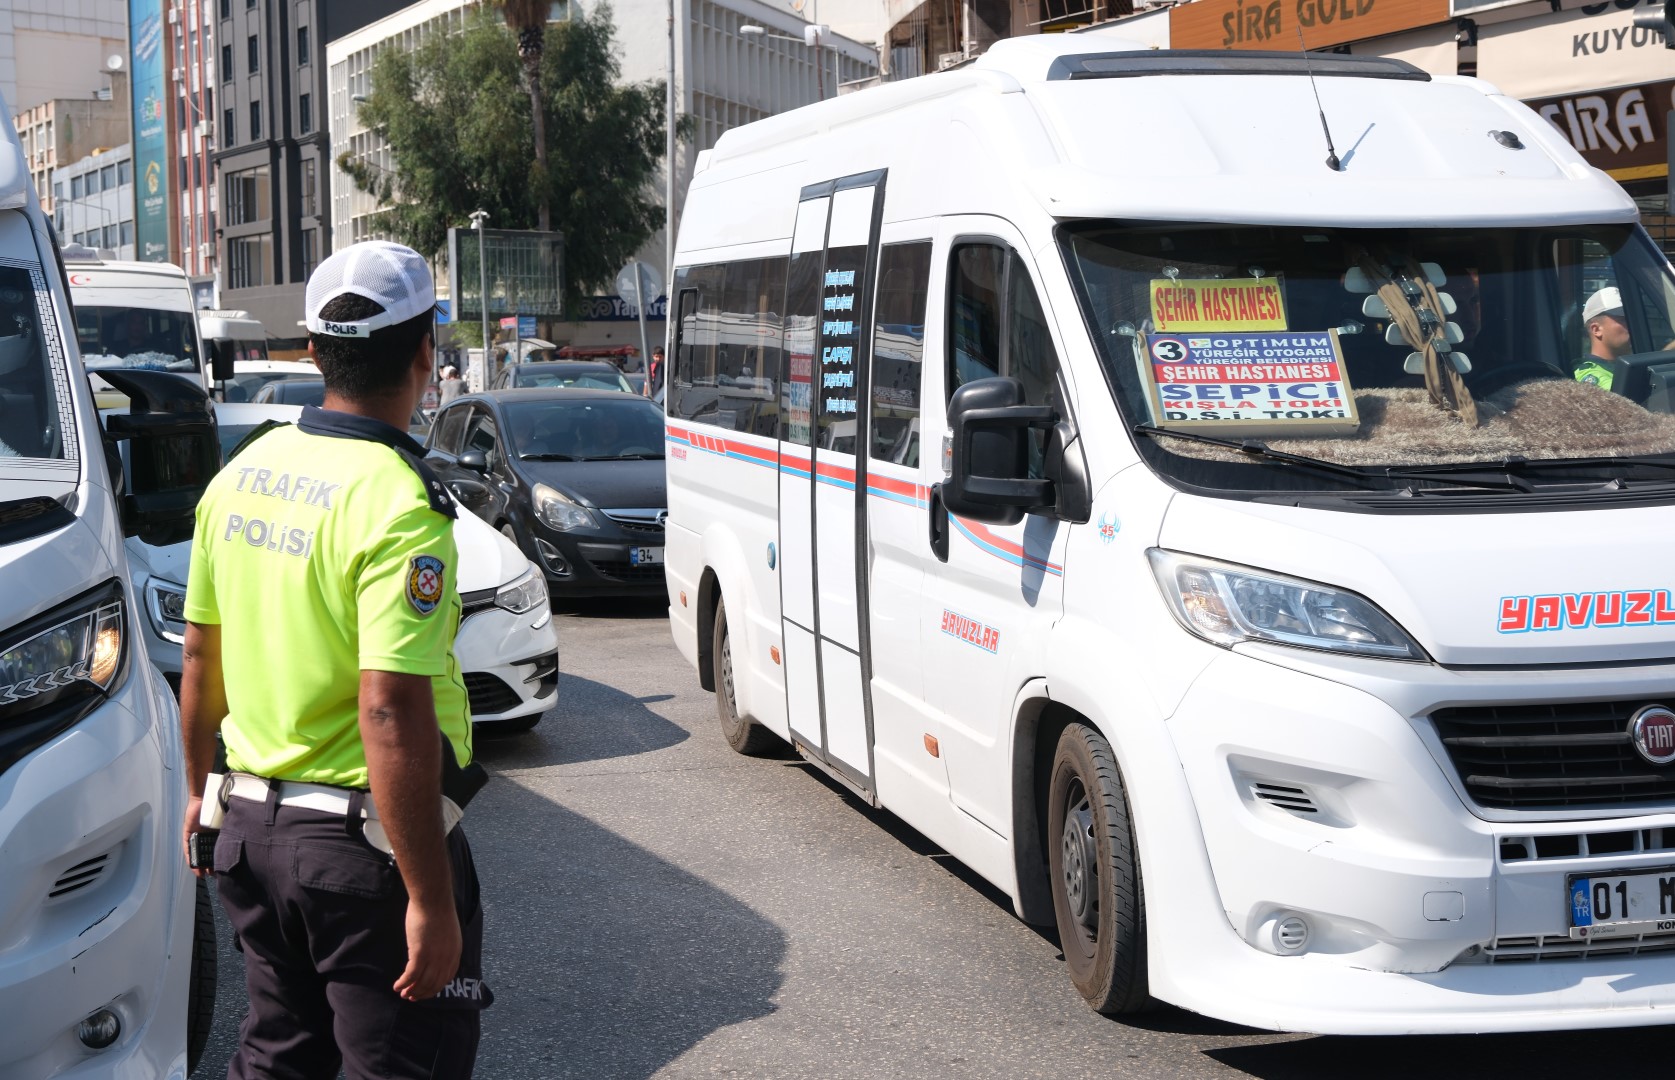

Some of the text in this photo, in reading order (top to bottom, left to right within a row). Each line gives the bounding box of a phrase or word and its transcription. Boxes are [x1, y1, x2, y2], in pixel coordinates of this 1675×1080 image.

[612, 299, 641, 318] Yap
[1155, 286, 1282, 330] ŞEHİR HASTANESİ
[325, 322, 357, 335] POLİS
[1159, 340, 1184, 360] 3
[1213, 338, 1328, 348] OPTİMUM
[1192, 348, 1330, 358] YÜREĞİR OTOGARI
[1256, 357, 1332, 365] BELEDİYESİ
[1162, 364, 1330, 383] ŞEHİR HASTANESİ
[1161, 382, 1339, 400] SEPİCİ
[1164, 399, 1342, 410] KIŞLA TOKİ
[1263, 410, 1345, 419] TOKİ
[236, 467, 342, 510] TRAFİK
[224, 514, 314, 559] POLİSİ
[639, 549, 653, 562] 34
[1497, 589, 1675, 634] YAVUZL
[941, 608, 1000, 655] YAVUZLAR
[1647, 724, 1674, 749] FIAT
[1593, 880, 1628, 920] 01
[1575, 906, 1590, 918] TR
[437, 977, 482, 1000] RAFİK
